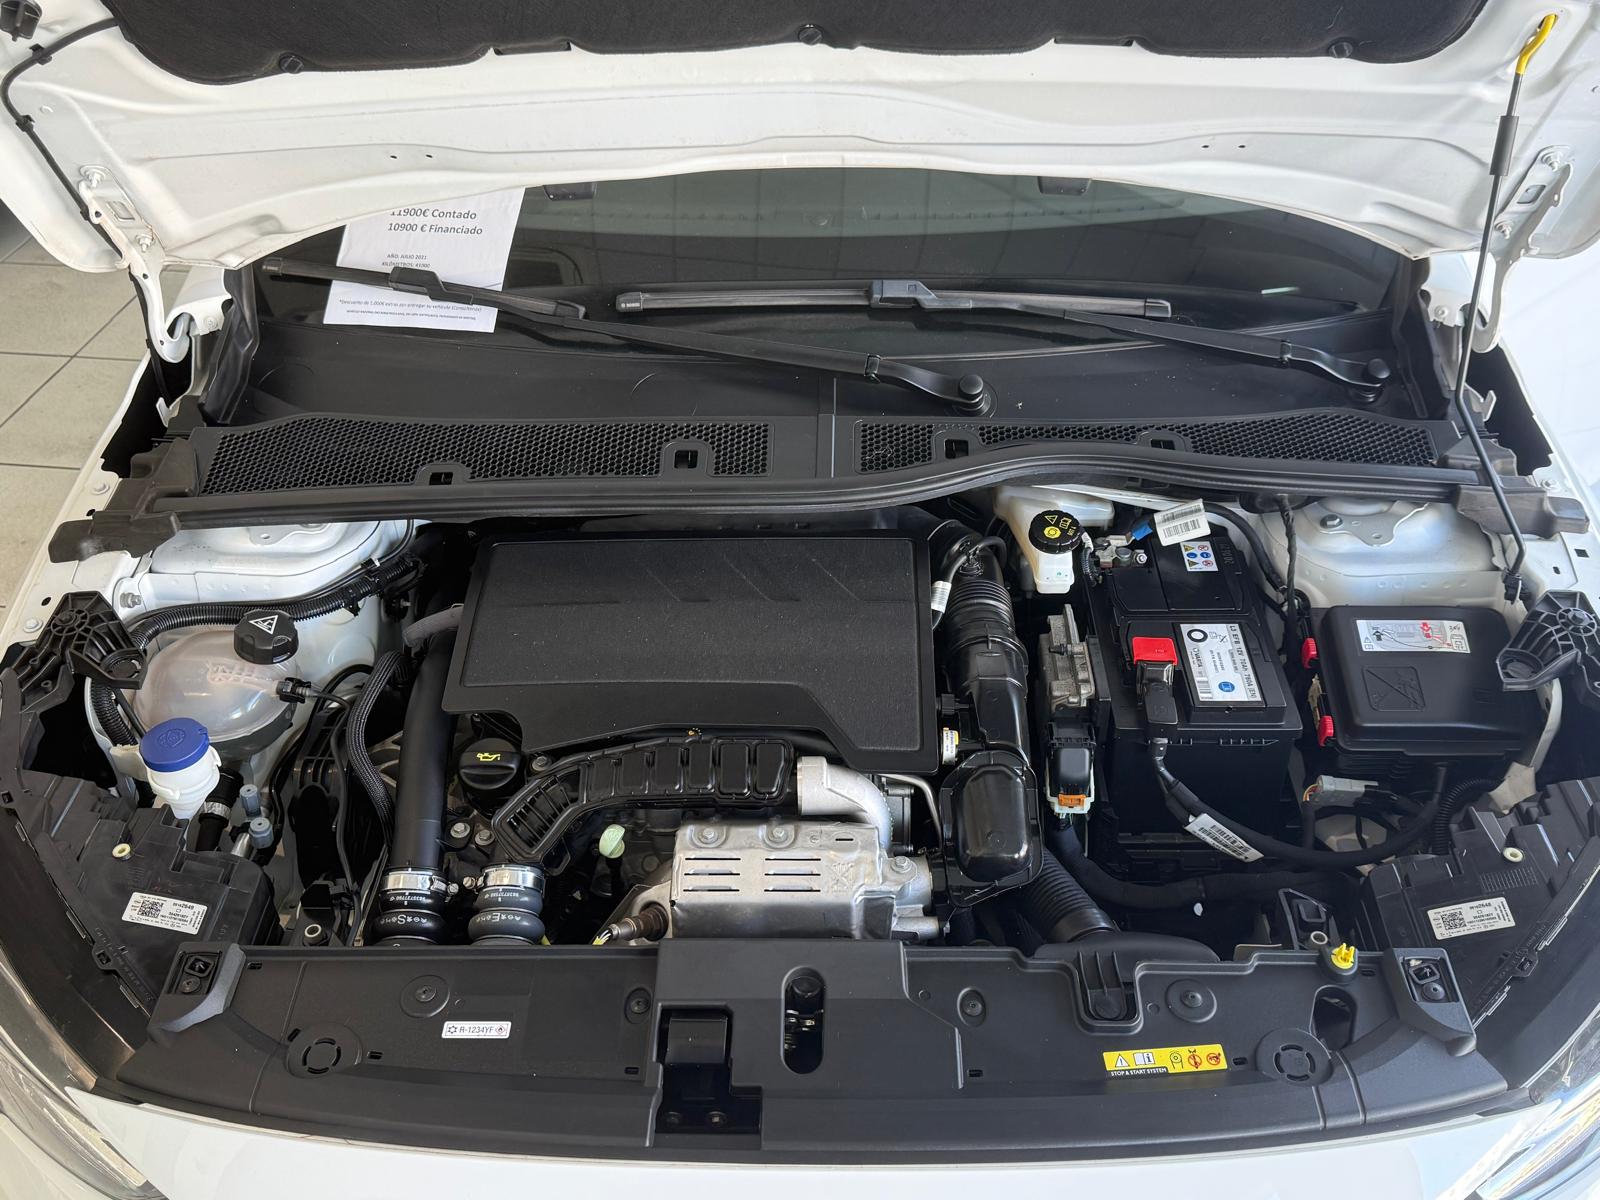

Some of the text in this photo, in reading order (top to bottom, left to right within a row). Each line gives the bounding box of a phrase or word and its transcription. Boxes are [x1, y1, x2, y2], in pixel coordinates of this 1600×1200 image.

[431, 209, 477, 220] Contado
[388, 223, 483, 235] 10900 € Financiado
[1232, 634, 1241, 644] EFB
